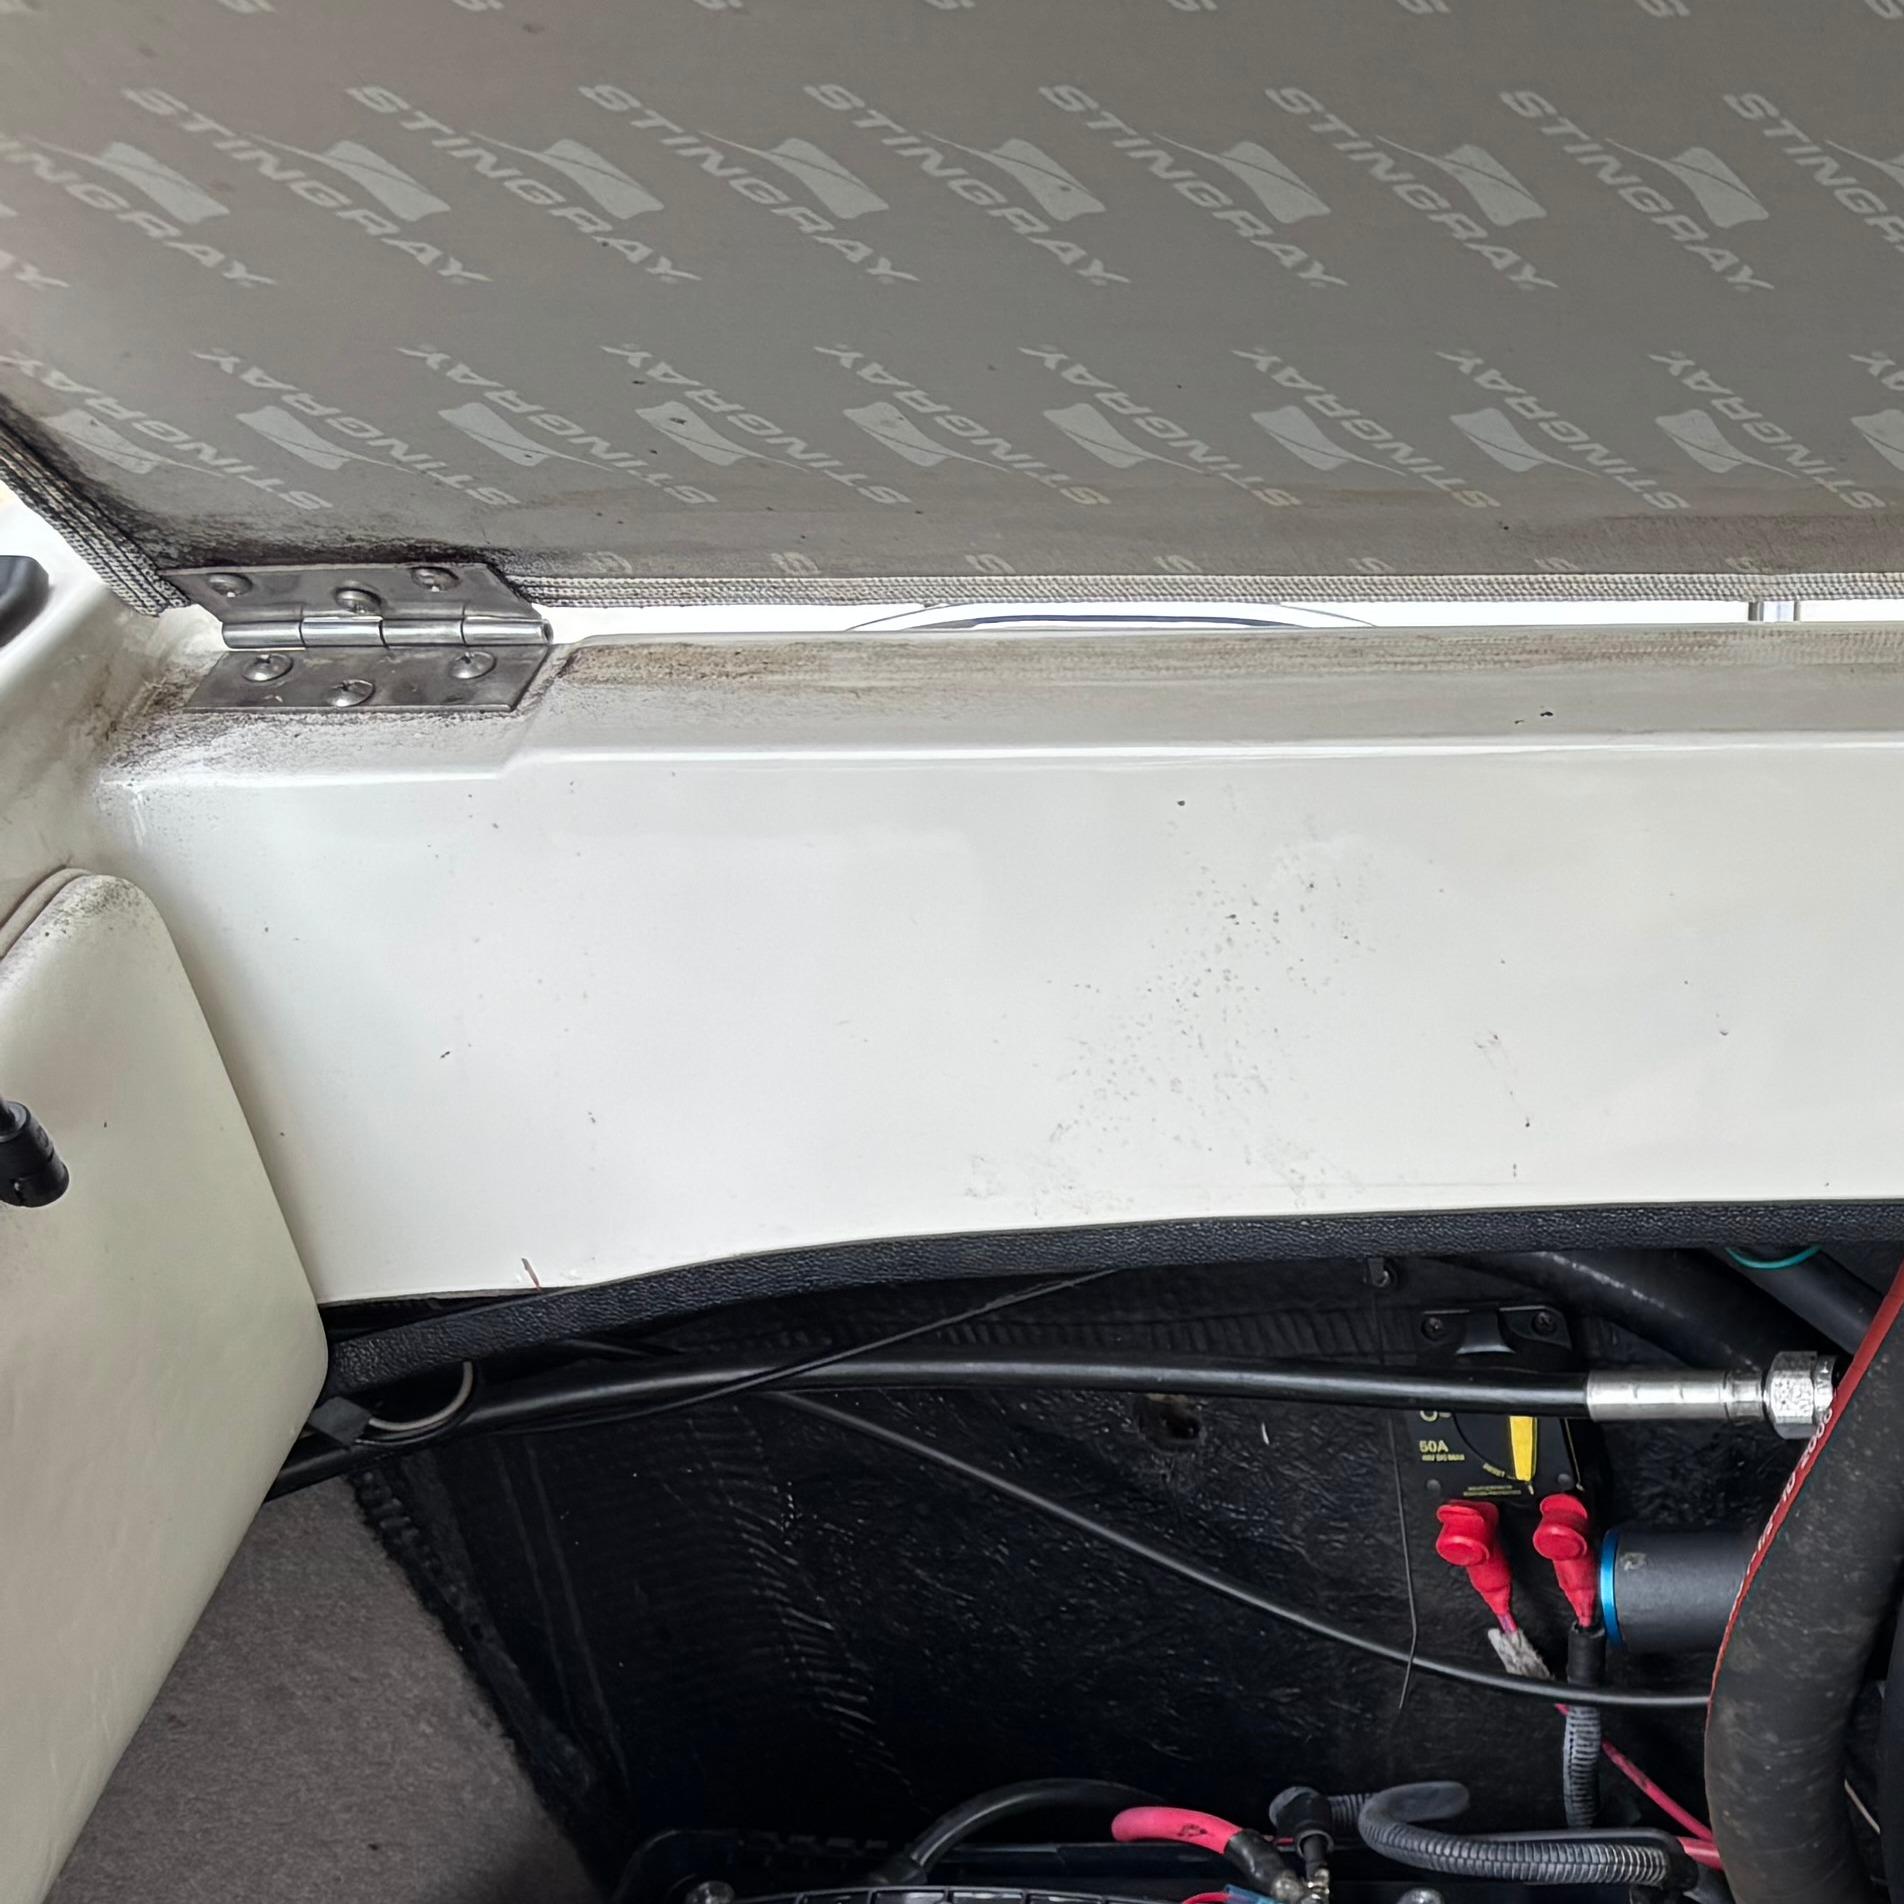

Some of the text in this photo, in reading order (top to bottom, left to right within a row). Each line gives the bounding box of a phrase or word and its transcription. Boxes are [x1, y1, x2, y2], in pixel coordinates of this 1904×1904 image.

[124, 86, 493, 282] STINGRAY
[347, 85, 703, 282] STINGRAY
[578, 84, 921, 282] STINGRAY
[804, 84, 1130, 284] STINGRAY
[1039, 85, 1348, 287] STINGRAY
[1265, 87, 1558, 289] STINGRAY
[1500, 90, 1775, 291] STINGRAY
[0, 355, 332, 509] STINGRAY
[193, 349, 519, 506] STINGRAY
[396, 345, 719, 505] STINGRAY
[600, 343, 911, 505] STINGRAY
[813, 345, 1111, 506] STINGRAY
[1018, 345, 1302, 508] STINGRAY
[1231, 346, 1501, 509] STINGRAY
[1436, 351, 1690, 510] STINGRAY
[1649, 351, 1886, 510] STINGRAY
[1419, 1440, 1448, 1452] 50A
